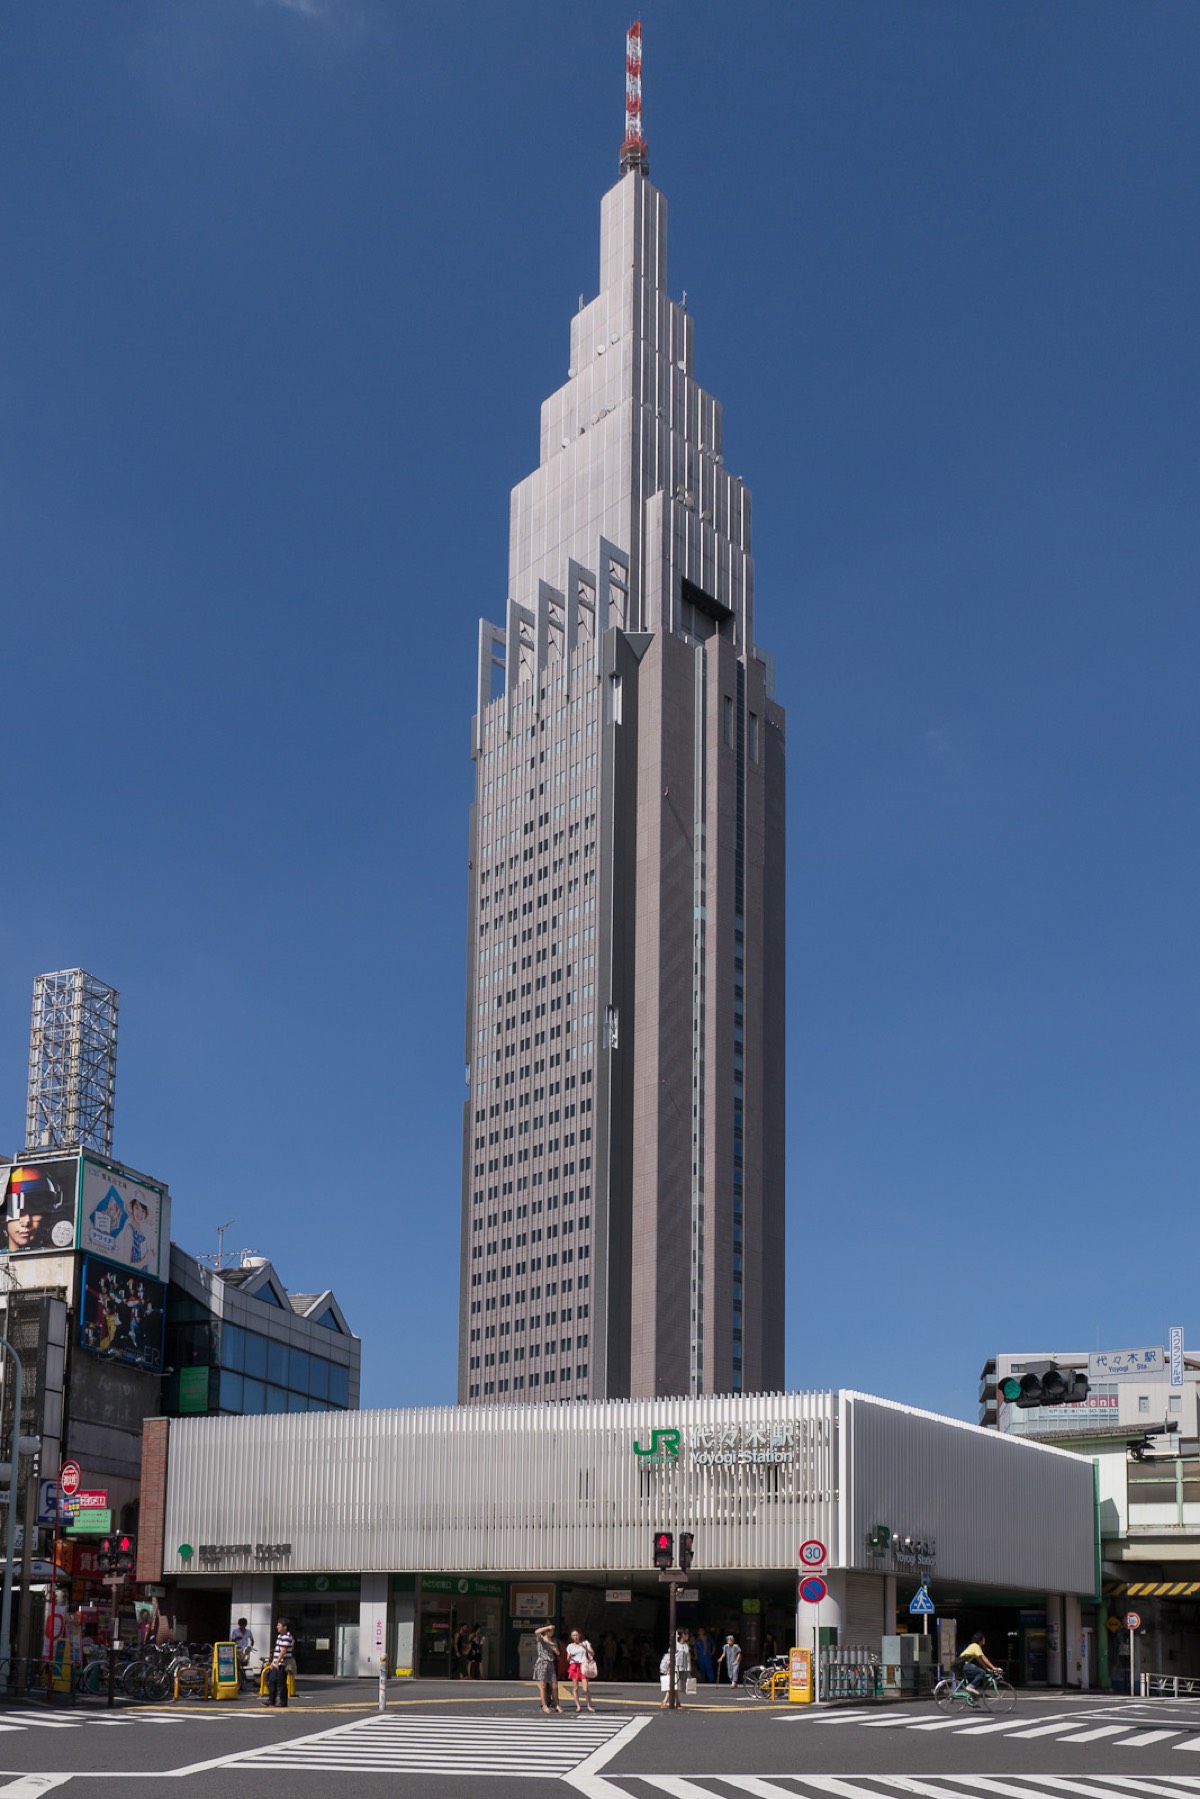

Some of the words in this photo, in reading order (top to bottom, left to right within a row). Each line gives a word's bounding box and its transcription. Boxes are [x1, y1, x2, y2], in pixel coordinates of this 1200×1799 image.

[1096, 1351, 1157, 1367] 代々木駅
[1172, 1330, 1182, 1383] スクランブル式
[1108, 1364, 1129, 1373] Yoyogi
[633, 1428, 681, 1456] JR
[690, 1424, 794, 1449] 代々木駅
[691, 1451, 737, 1467] Yoyogi
[743, 1450, 793, 1464] Station
[866, 1525, 891, 1549] JR
[804, 1547, 821, 1559] 30
[896, 1552, 917, 1565] Yoyogi
[918, 1553, 937, 1566] Station
[375, 1620, 383, 1636] 北口
